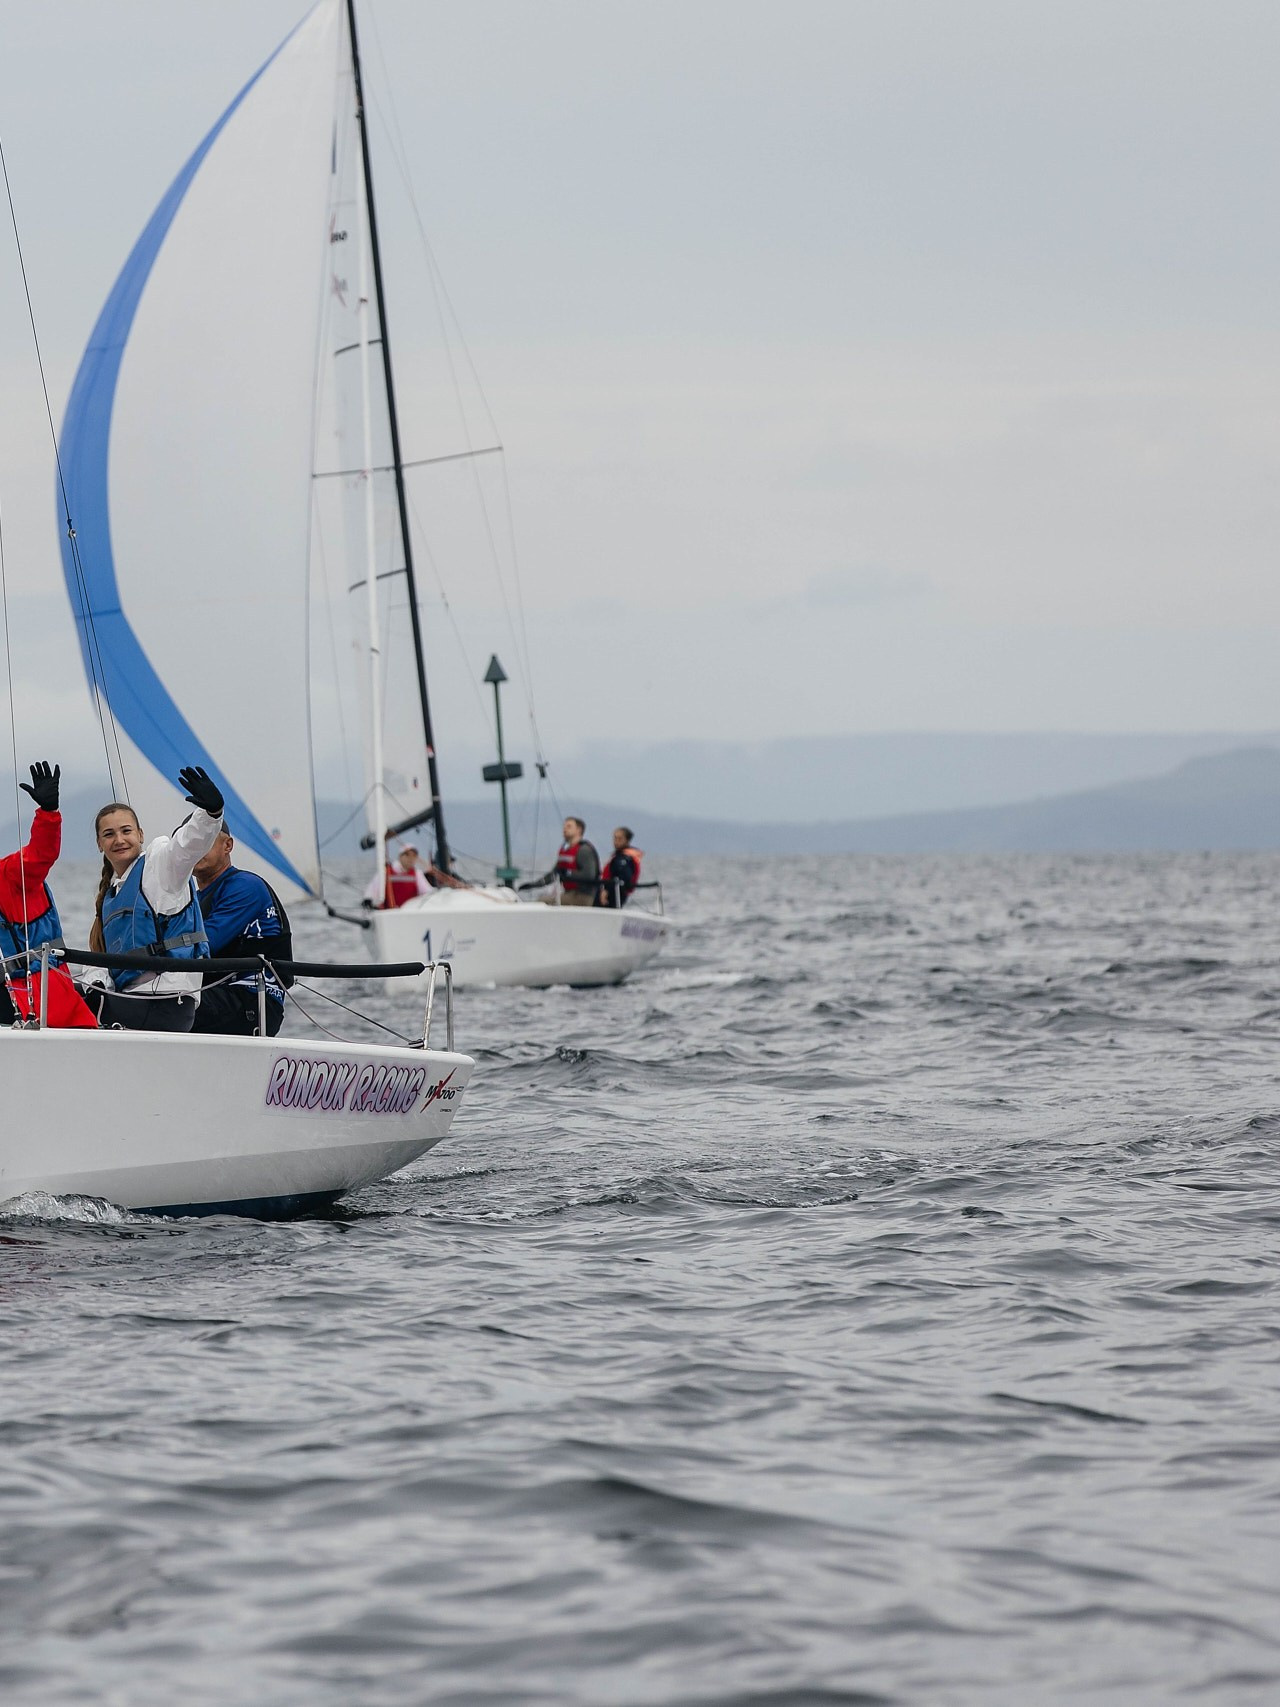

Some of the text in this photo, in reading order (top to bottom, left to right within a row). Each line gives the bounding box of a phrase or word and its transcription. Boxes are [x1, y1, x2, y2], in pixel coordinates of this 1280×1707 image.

[423, 929, 431, 961] 1
[266, 1057, 426, 1113] RUNDUK RACING
